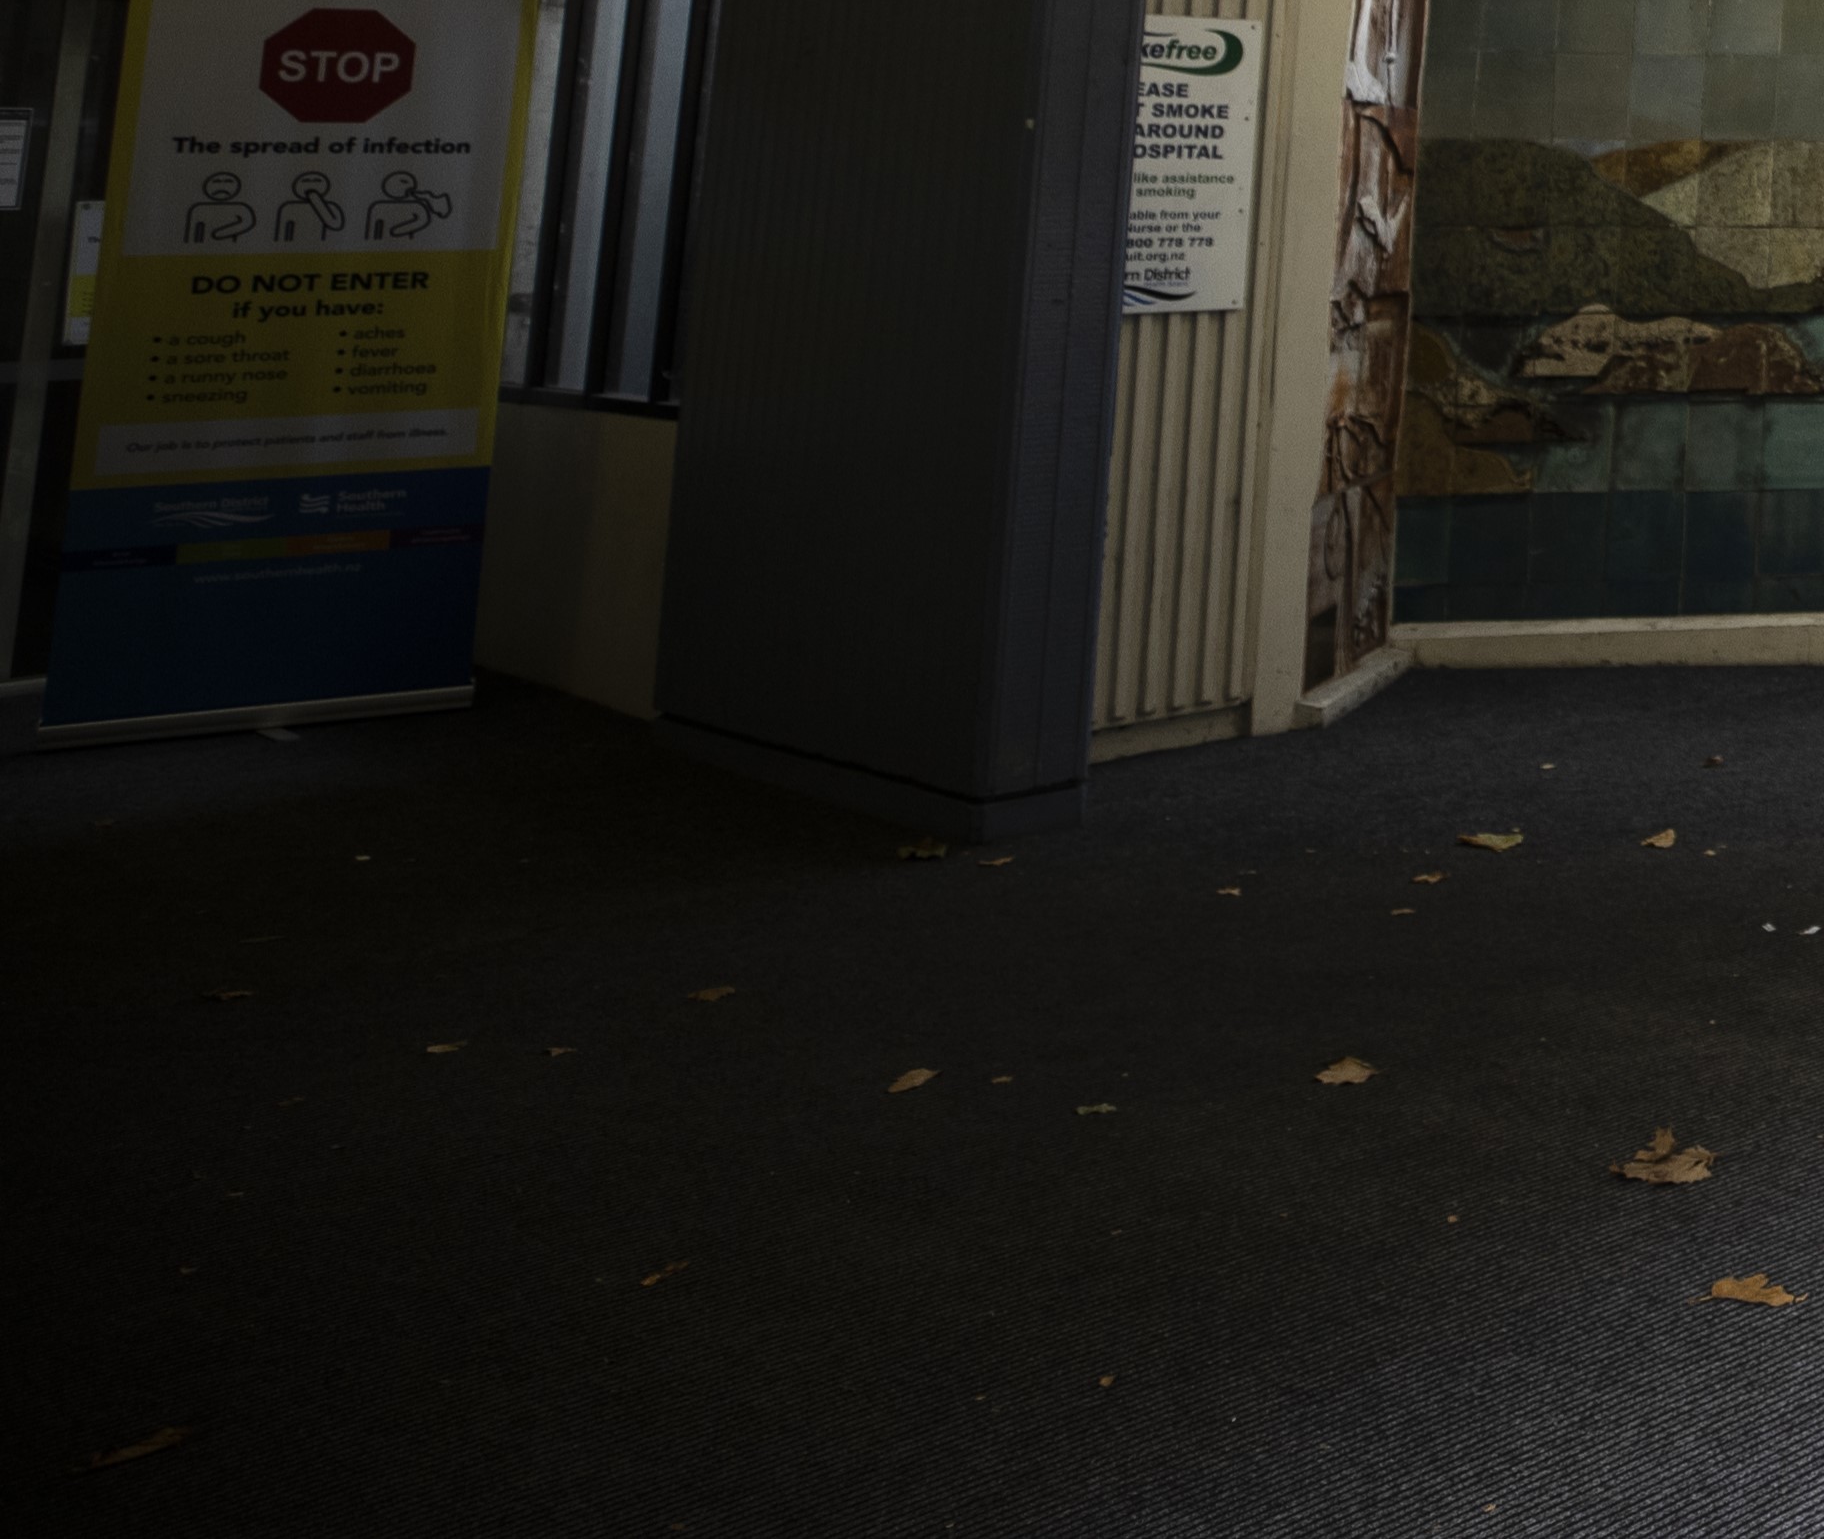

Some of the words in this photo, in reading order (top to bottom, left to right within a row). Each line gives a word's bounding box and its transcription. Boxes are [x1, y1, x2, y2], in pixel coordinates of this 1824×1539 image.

[278, 49, 400, 83] STOP
[1152, 103, 1229, 119] SMOKE
[1135, 123, 1225, 138] AROUND
[173, 137, 219, 153] The
[230, 137, 320, 158] spread
[329, 137, 357, 153] of
[363, 137, 470, 154] infection
[1133, 143, 1224, 159] OSPITAL
[1133, 172, 1158, 184] like
[1162, 172, 1235, 184] assistance
[1136, 186, 1196, 200] smoking
[1159, 209, 1189, 220] from
[1192, 211, 1221, 223] your
[1165, 224, 1178, 233] or
[1182, 222, 1201, 232] the
[1157, 237, 1184, 247] 778
[1187, 237, 1214, 247] 778
[1144, 266, 1191, 281] District
[192, 275, 241, 293] DO
[252, 273, 321, 292] NOT
[331, 272, 429, 290] ENTER
[232, 301, 253, 318] if
[260, 304, 306, 322] you
[315, 299, 384, 316] have:
[169, 336, 180, 346] a
[186, 331, 246, 348] cough
[354, 326, 405, 339] aches
[166, 355, 177, 365] a
[184, 353, 225, 364] sore
[232, 350, 289, 363] throat
[352, 345, 399, 358] fever
[164, 374, 175, 384] a
[181, 372, 236, 385] runny
[242, 369, 288, 381] nose
[350, 363, 436, 377] diarrhoea
[348, 381, 427, 396] vomiting
[162, 389, 248, 404] sneezing
[127, 442, 150, 452] Our
[153, 440, 177, 453] job
[181, 440, 192, 449] is
[195, 440, 209, 449] to
[211, 437, 262, 450] protect
[264, 435, 315, 448] patients
[319, 432, 343, 442] and
[337, 490, 407, 501] Southern
[154, 501, 217, 512] Southern
[221, 495, 270, 508] District
[336, 501, 385, 512] Health
